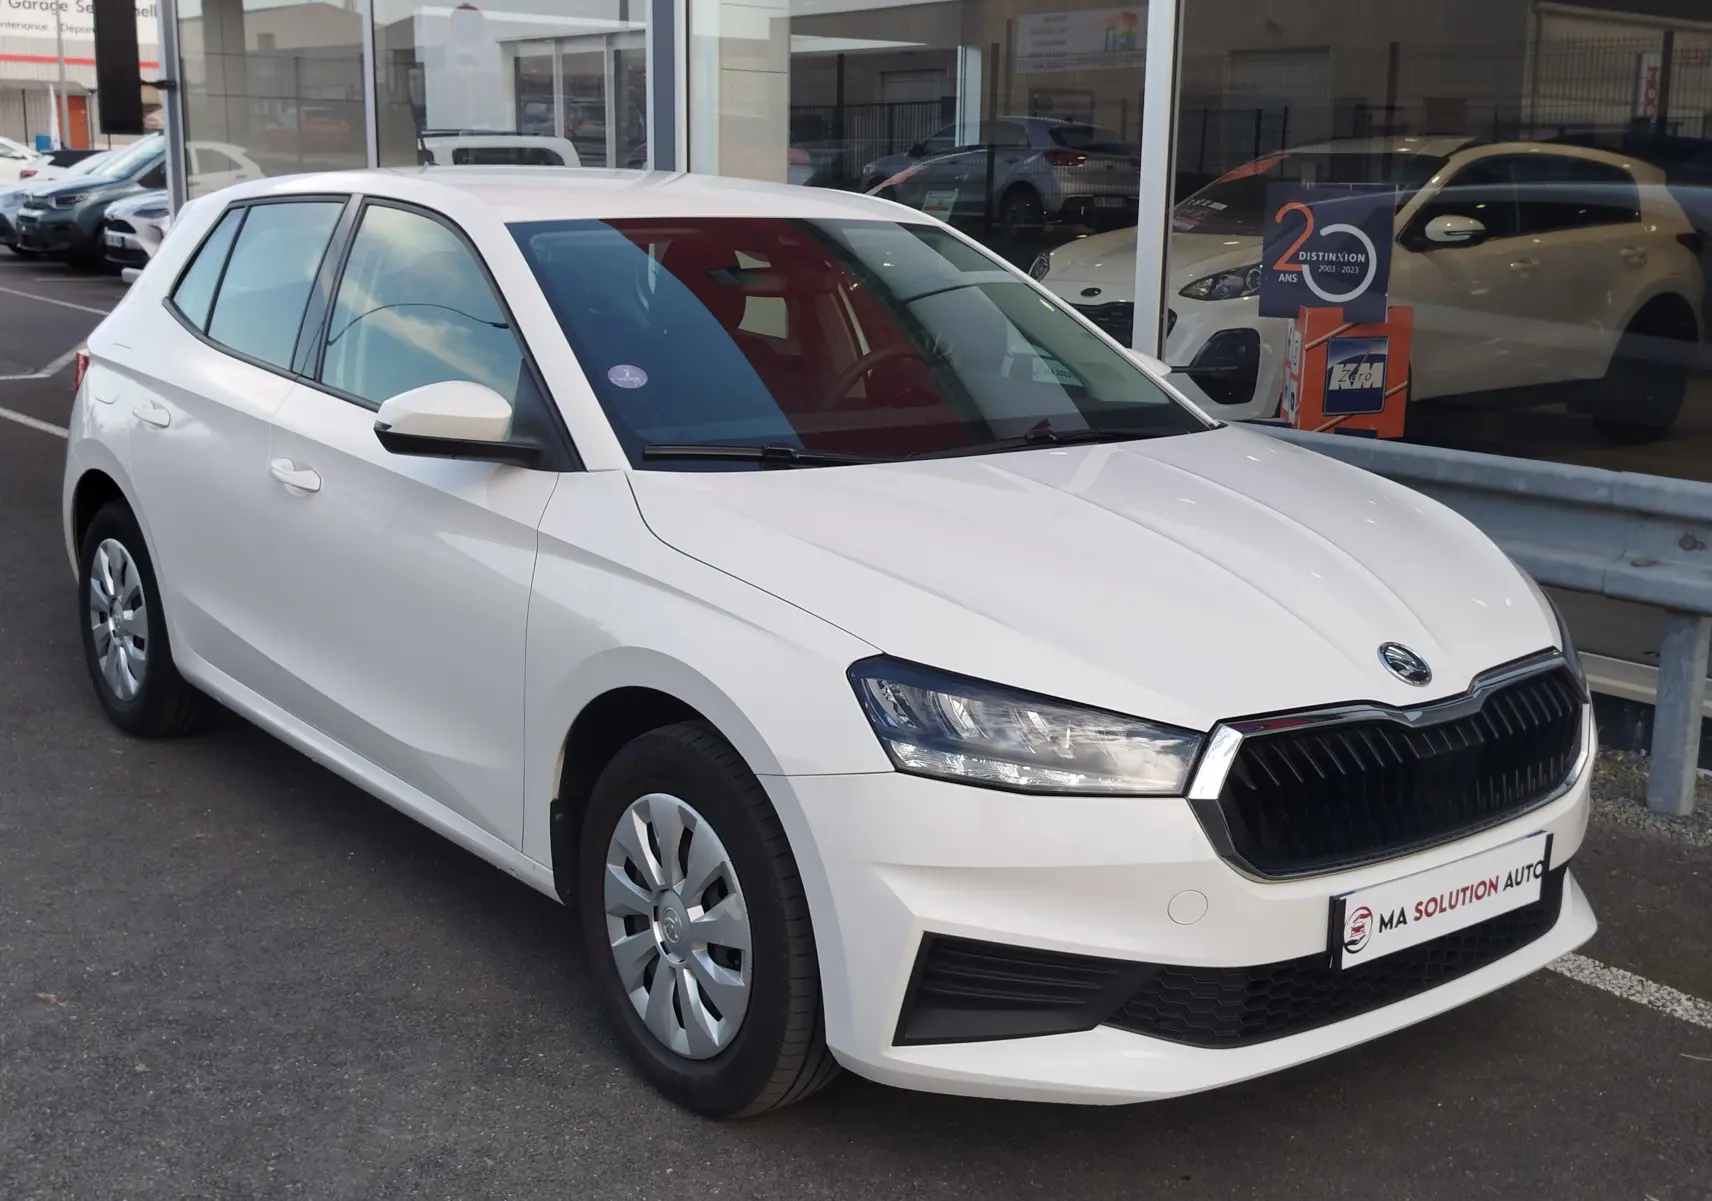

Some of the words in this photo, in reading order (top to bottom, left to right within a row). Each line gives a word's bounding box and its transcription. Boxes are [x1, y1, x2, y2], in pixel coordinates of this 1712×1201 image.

[8, 0, 68, 15] Garage
[1299, 251, 1366, 263] DISTINXION
[1319, 265, 1335, 273] 2003
[1341, 265, 1359, 274] 2023
[1278, 273, 1298, 283] ANS
[1328, 362, 1384, 390] KM
[1378, 906, 1408, 933] MA
[1413, 875, 1500, 922] SOLUTION
[1503, 859, 1545, 891] AUTO
